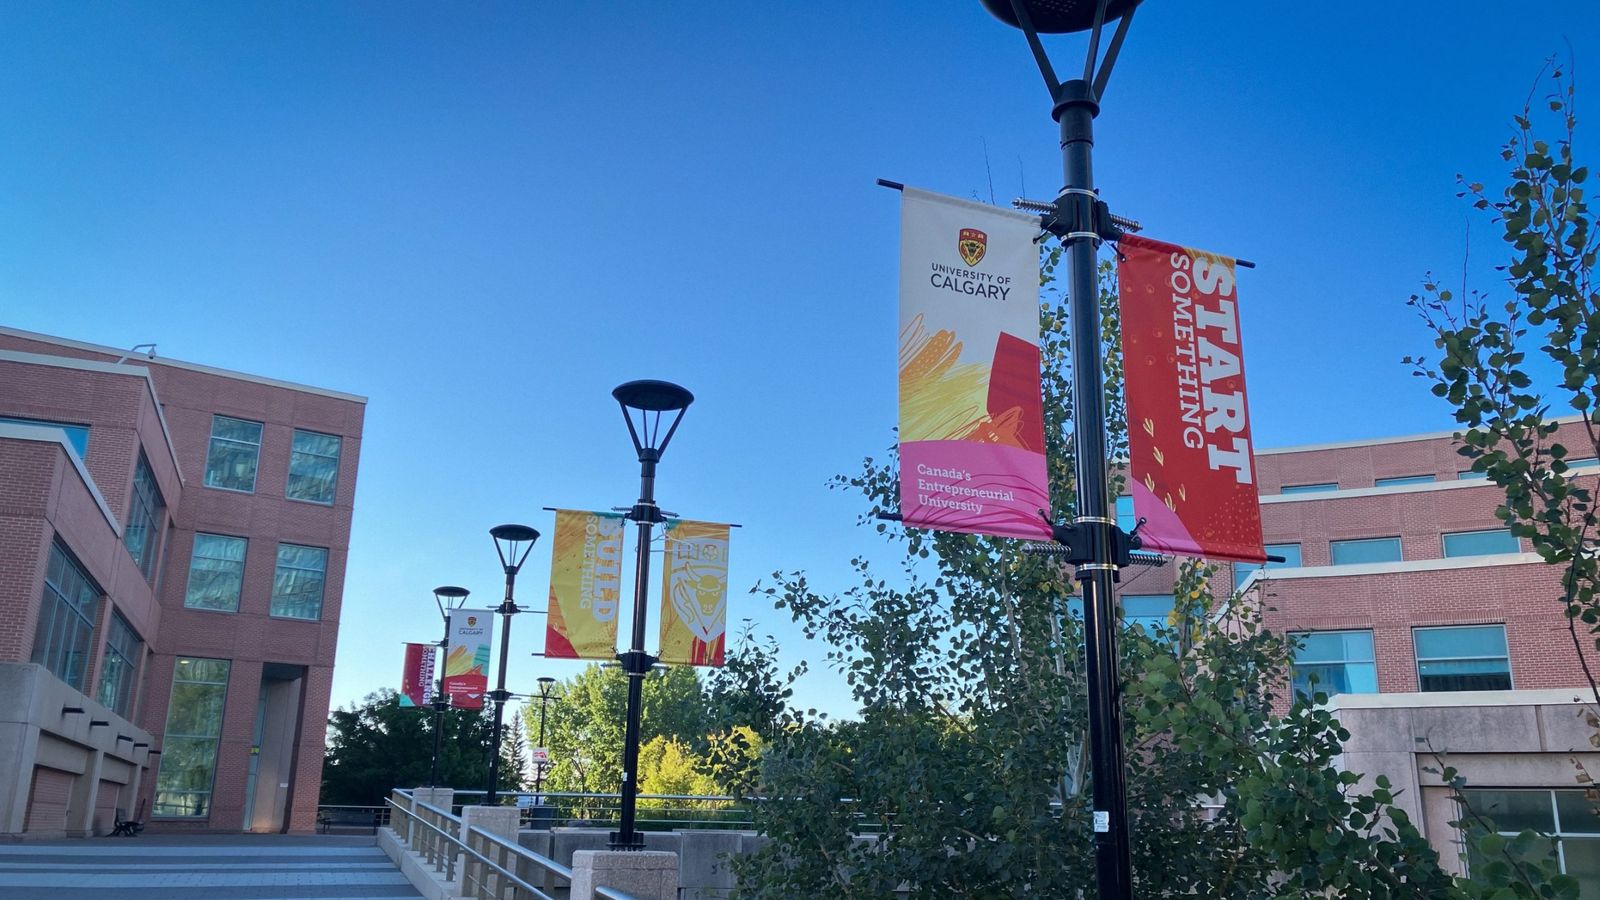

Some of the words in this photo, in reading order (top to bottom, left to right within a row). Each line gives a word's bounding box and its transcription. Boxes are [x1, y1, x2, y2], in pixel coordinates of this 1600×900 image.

[930, 273, 1011, 301] CALGARY
[931, 262, 993, 282] UNIVERSITY
[996, 275, 1011, 285] OF
[1170, 252, 1204, 449] SOMETHING
[1192, 258, 1253, 484] START
[917, 463, 972, 481] Canada's
[918, 478, 1015, 502] Entrepreneurial
[918, 494, 983, 515] University
[581, 516, 598, 608] SOMETHING
[593, 516, 623, 622] BUILD
